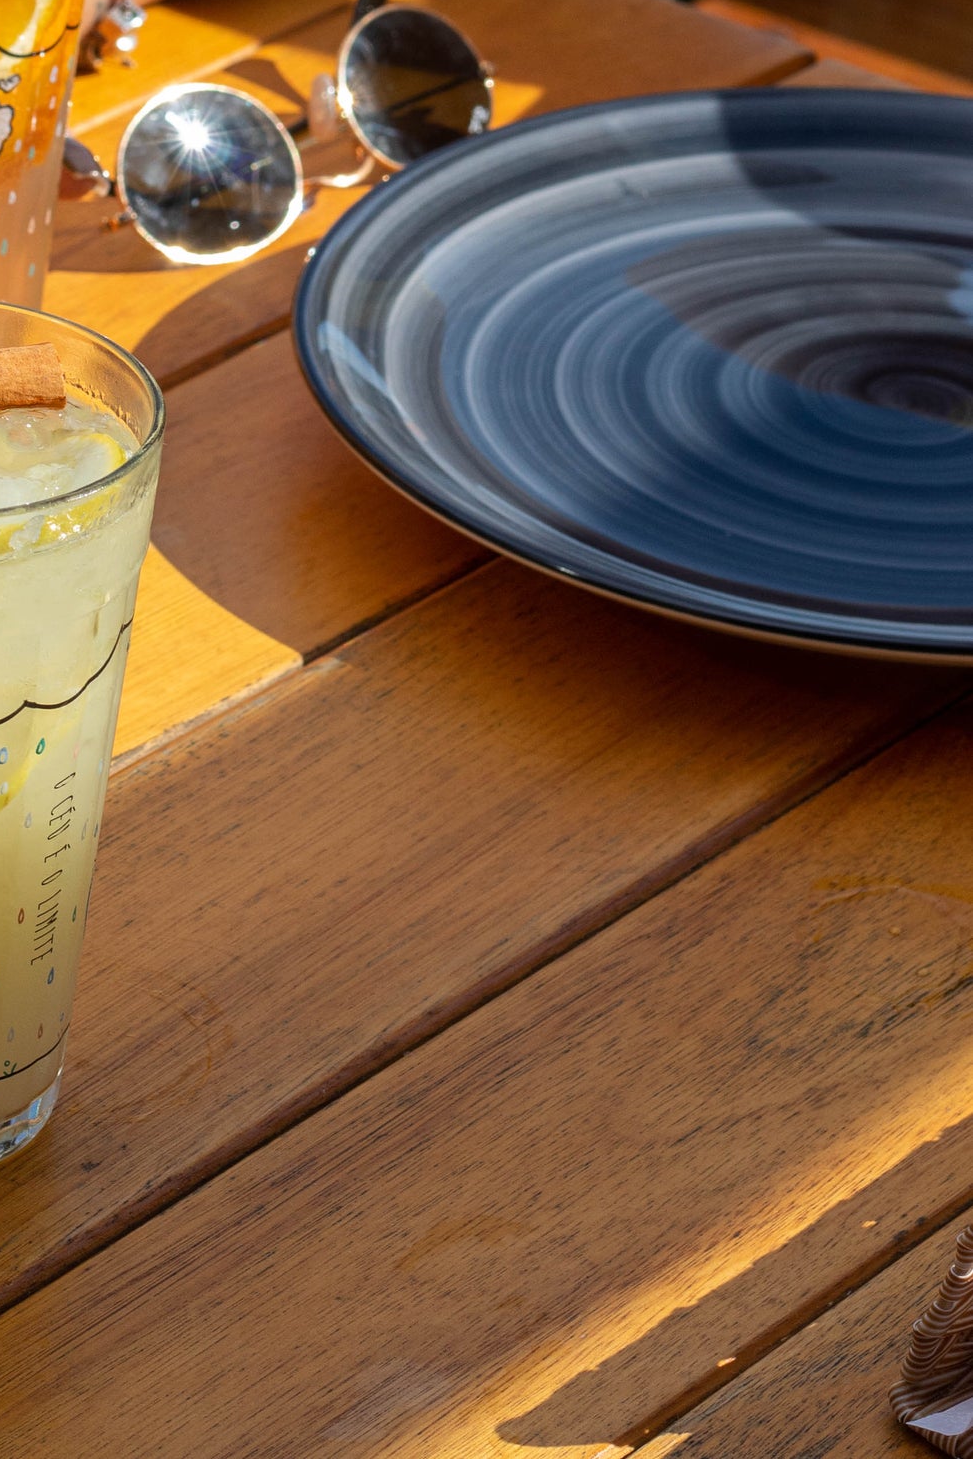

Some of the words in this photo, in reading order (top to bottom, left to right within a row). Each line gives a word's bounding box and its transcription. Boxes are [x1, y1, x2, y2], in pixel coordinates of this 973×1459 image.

[43, 842, 71, 863] É
[40, 868, 64, 887] O
[29, 888, 63, 967] LIMITE
